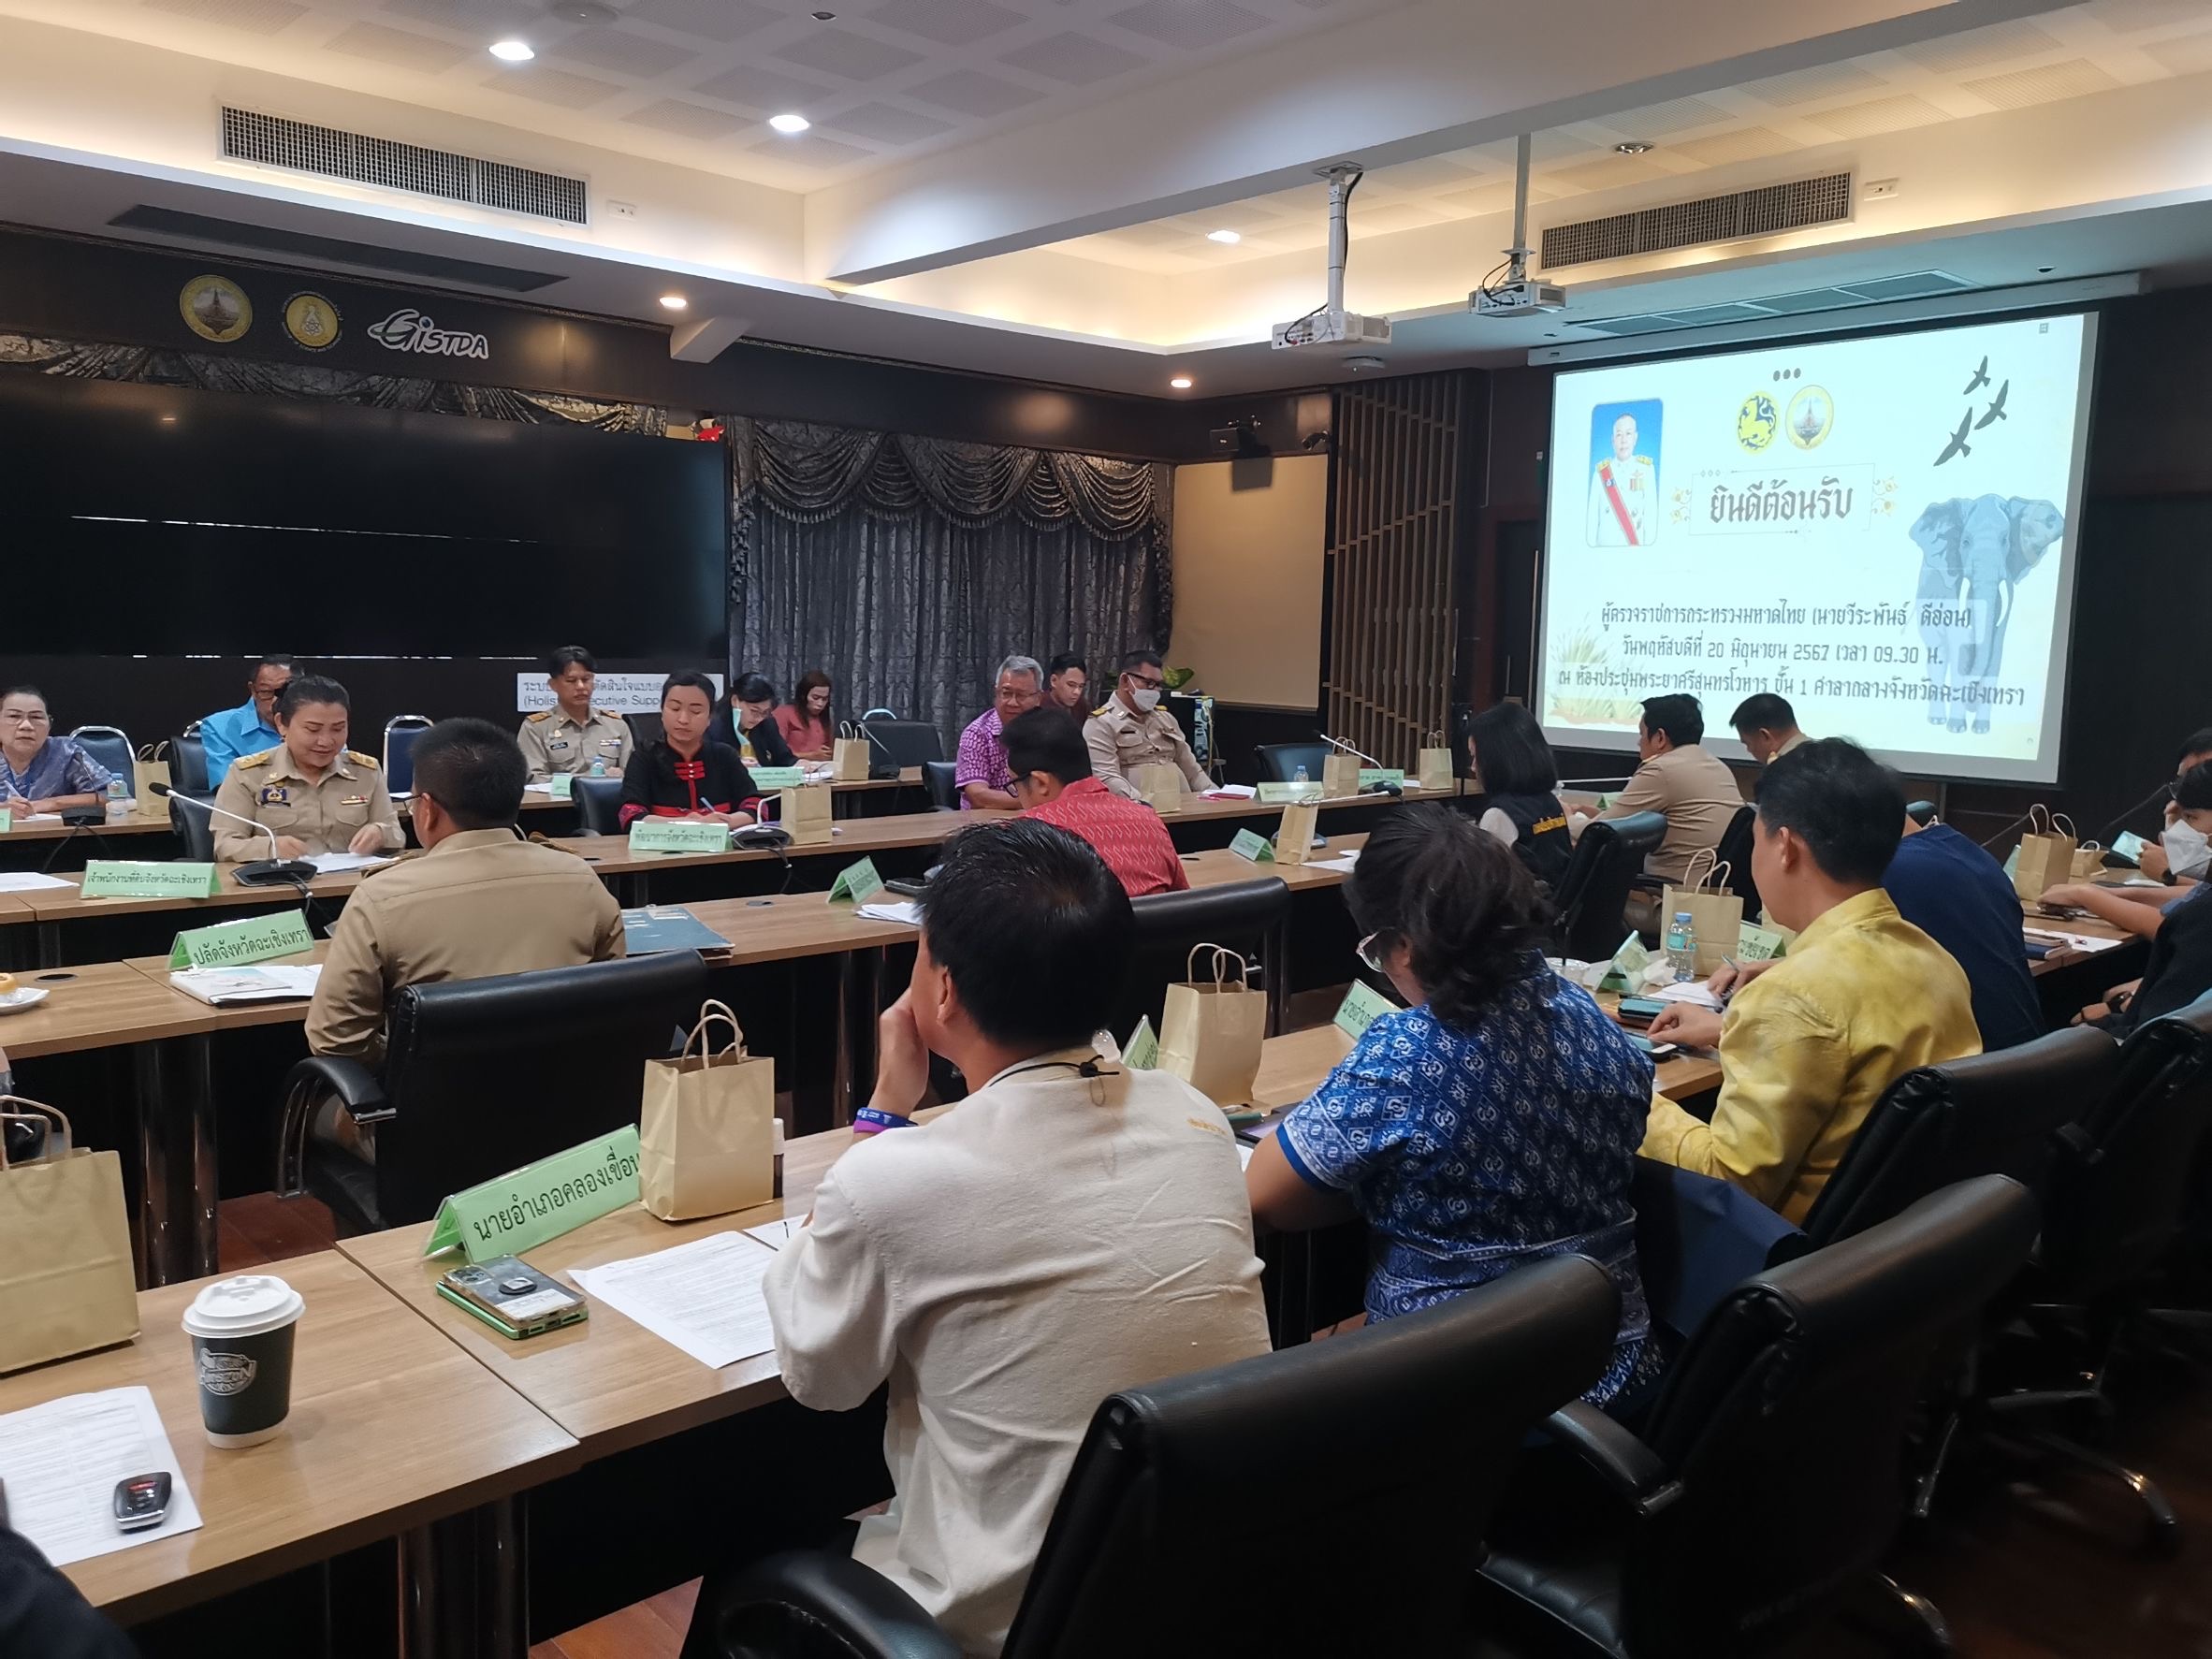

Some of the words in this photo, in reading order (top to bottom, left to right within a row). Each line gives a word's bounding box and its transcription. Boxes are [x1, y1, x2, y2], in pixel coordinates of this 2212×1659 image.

[1710, 475, 1854, 523] ยินดีต้อนรับ
[1601, 599, 1806, 631] ผู้ตรวจราชการกระทรวงมหาดไทย
[1623, 630, 1704, 659] วันพฤหัสบดีที่
[1707, 642, 1724, 658] 20
[1730, 638, 1787, 666] มิถุนายน
[1793, 643, 1829, 662] 2567
[1835, 645, 1868, 662] เวลา
[1873, 646, 1919, 664] 09.30
[1927, 647, 1943, 664] น.
[632, 695, 662, 707] Supp
[1558, 669, 1571, 685] ณ
[1774, 665, 1794, 695] ชั้น
[1799, 679, 1807, 695] 1
[1813, 675, 2025, 707] ศาลากลางจังหวัดฉะเชิงเทรา
[193, 929, 310, 965] ปลัดจังหวัดฉะเชิงเทรา
